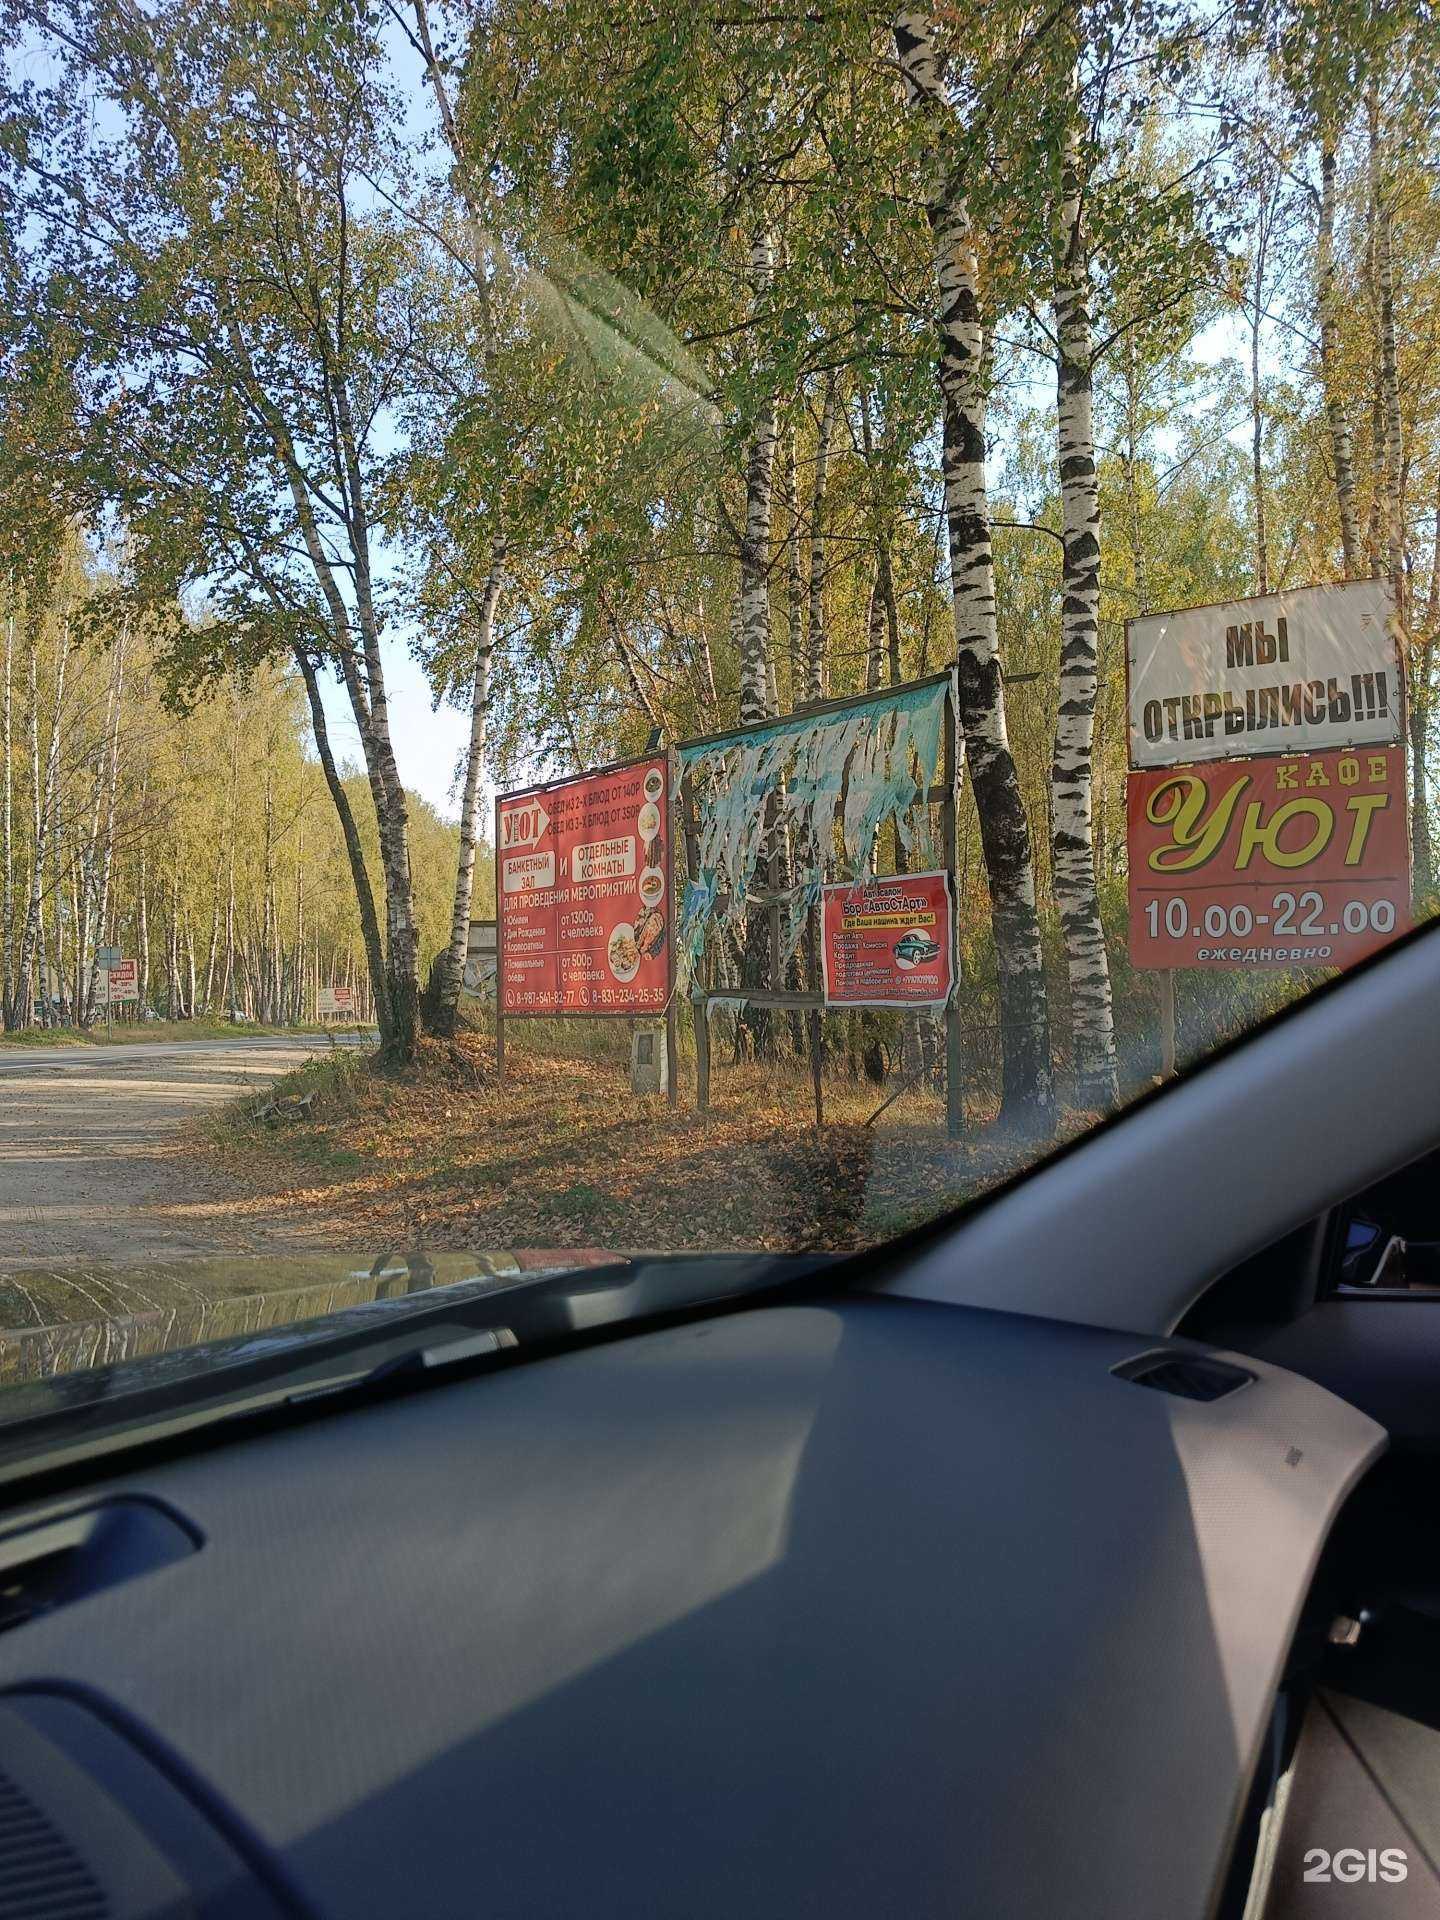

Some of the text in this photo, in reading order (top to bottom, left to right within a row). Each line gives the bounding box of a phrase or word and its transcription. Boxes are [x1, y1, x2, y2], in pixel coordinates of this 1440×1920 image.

[1226, 617, 1289, 669] МЫ
[1143, 671, 1388, 743] ОТКРЫЛИСЬ!!!
[1276, 756, 1387, 790] КАФЕ
[588, 789, 610, 806] БЛЮД
[612, 786, 622, 800] ОТ
[588, 810, 609, 828] БЛЮД
[611, 808, 621, 822] ОТ
[578, 839, 629, 862] ОТДЕЛЬНЫЕ
[508, 854, 550, 875] БАНКЕТНЫЙ
[560, 857, 568, 876] И
[581, 859, 625, 879] КОМНАТЫ
[521, 875, 535, 890] ЗАЛ
[504, 876, 637, 912] ДЛЯ ПРОВЕДЕНИЯ МЕРОПРИЯТИЙ
[863, 887, 902, 898] Автосалон
[561, 910, 594, 926] от 1300р
[843, 902, 862, 917] Бор
[1144, 891, 1396, 938] 10.00-22.00
[844, 918, 855, 928] Где
[873, 917, 898, 925] машина
[567, 926, 604, 939] человека
[562, 953, 593, 970] от 500р
[1197, 945, 1331, 962] ежедневно
[507, 973, 526, 984] обеды
[568, 970, 605, 982] человека
